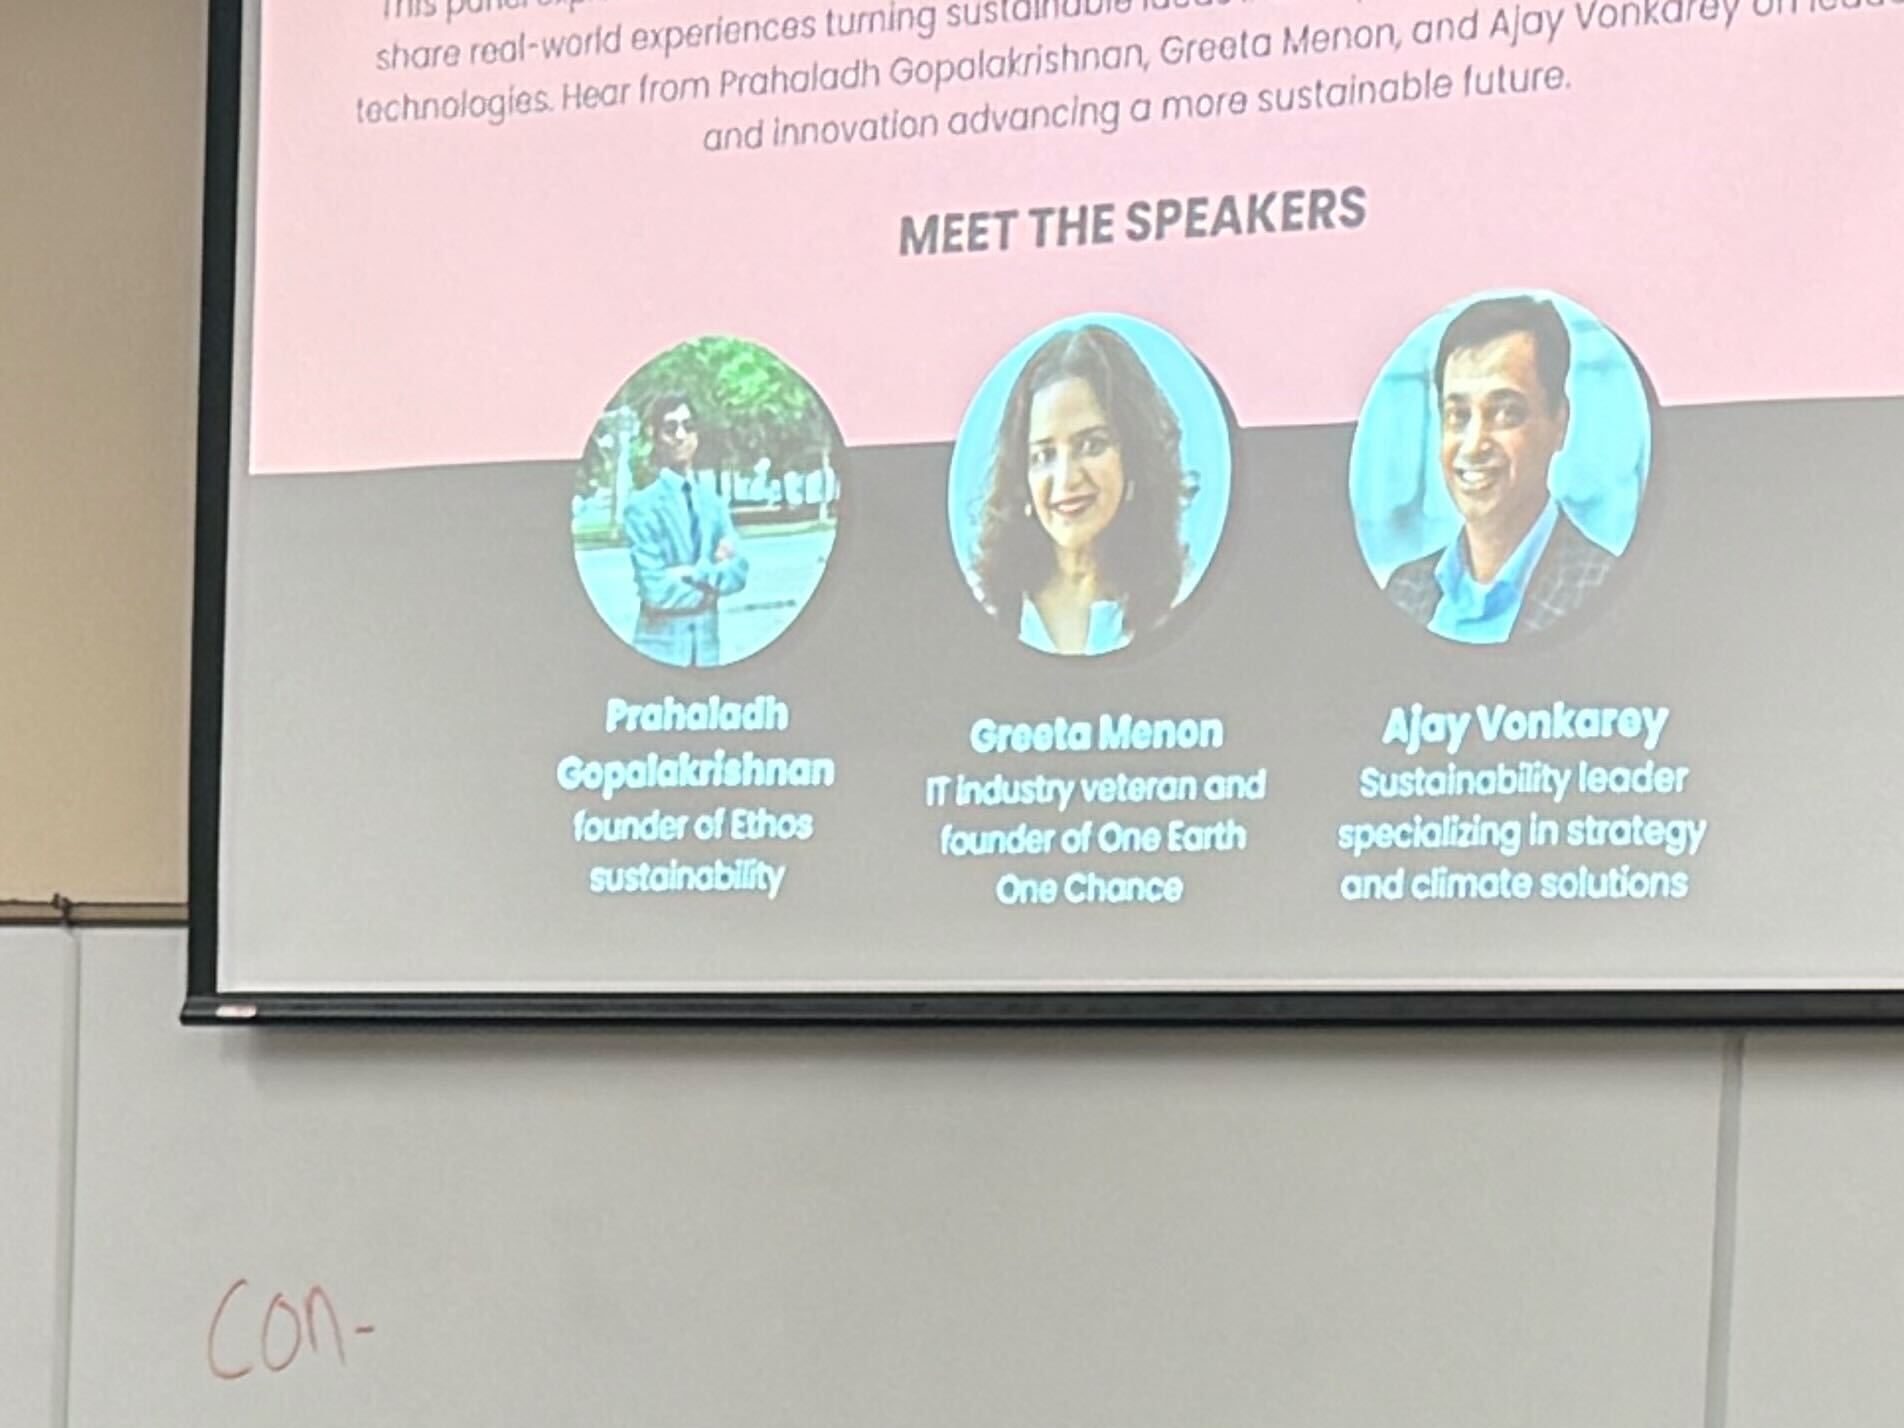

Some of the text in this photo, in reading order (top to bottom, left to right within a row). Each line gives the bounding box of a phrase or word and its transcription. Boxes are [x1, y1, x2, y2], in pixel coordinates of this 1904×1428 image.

[376, 43, 460, 71] share
[469, 24, 621, 65] real-world
[631, 14, 816, 58] experiences
[825, 1, 937, 39] turning
[356, 84, 554, 126] technologies.
[562, 80, 631, 111] Hear
[639, 74, 710, 104] from
[720, 58, 880, 98] Prahaladh
[889, 42, 1150, 93] Gopalakrishnan,
[1160, 30, 1272, 66] Greeta
[1283, 22, 1402, 56] Menon,
[1412, 9, 1479, 44] and
[1489, 3, 1565, 48] Ajay
[703, 64, 1571, 151] and innovation advancing a more sustainable future.
[899, 186, 1367, 256] MEET THE SPEAKERS
[606, 695, 789, 732] Prahaladh
[969, 714, 1224, 755] Greeta Menon
[1382, 701, 1669, 755] Ajay Vonkarey
[557, 748, 835, 800] Gopalakrishnan
[926, 768, 1267, 813] IT industry veteran and
[1359, 761, 1688, 803] Sustainability leader
[574, 808, 814, 843] founder of Ethos
[941, 818, 1246, 856] founder of One Earth
[1337, 812, 1707, 857] specializing in strategy
[590, 858, 786, 899] sustainability
[995, 871, 1184, 904] One Chance
[1340, 864, 1688, 901] and climate solutions
